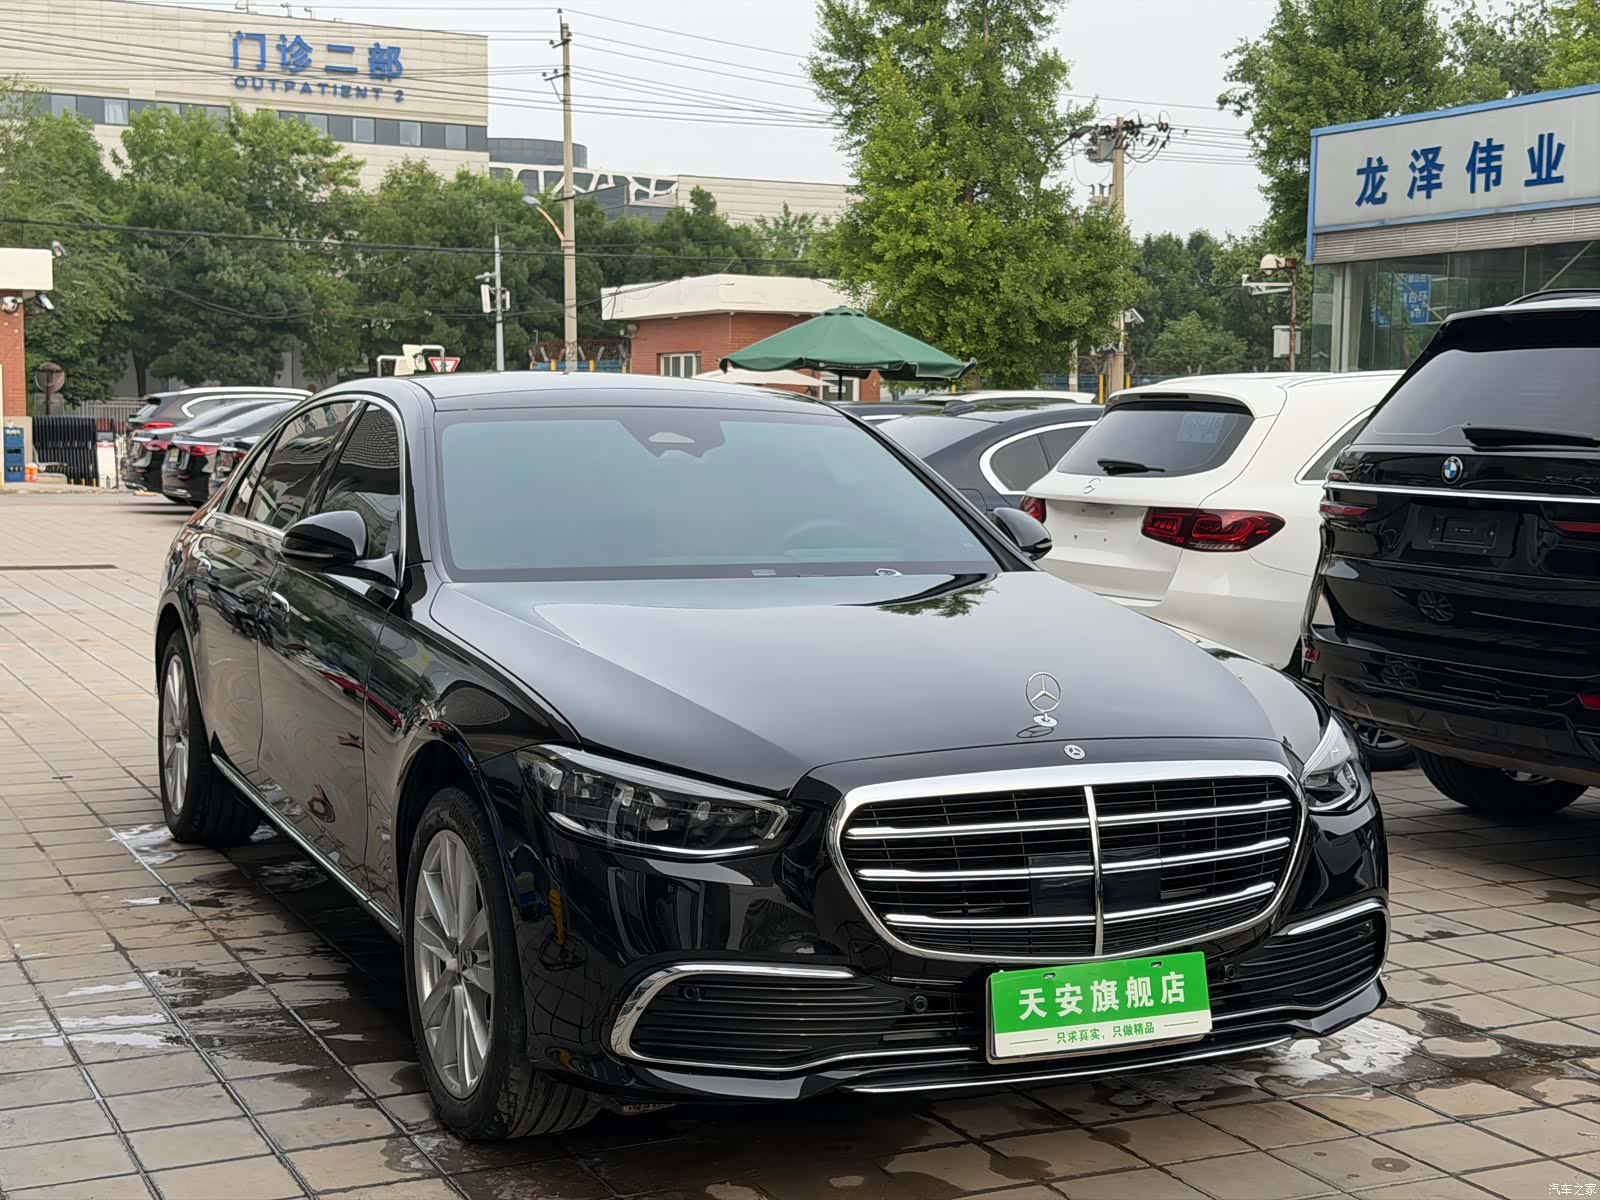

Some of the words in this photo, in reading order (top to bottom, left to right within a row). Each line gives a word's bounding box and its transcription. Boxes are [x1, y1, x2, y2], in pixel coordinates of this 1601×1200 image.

[232, 30, 403, 82] 门诊二部
[234, 75, 383, 99] OUTPATIENT
[394, 89, 405, 102] 2
[1354, 132, 1566, 207] 龙泽伟业
[1018, 971, 1185, 1021] 天安旗舰店
